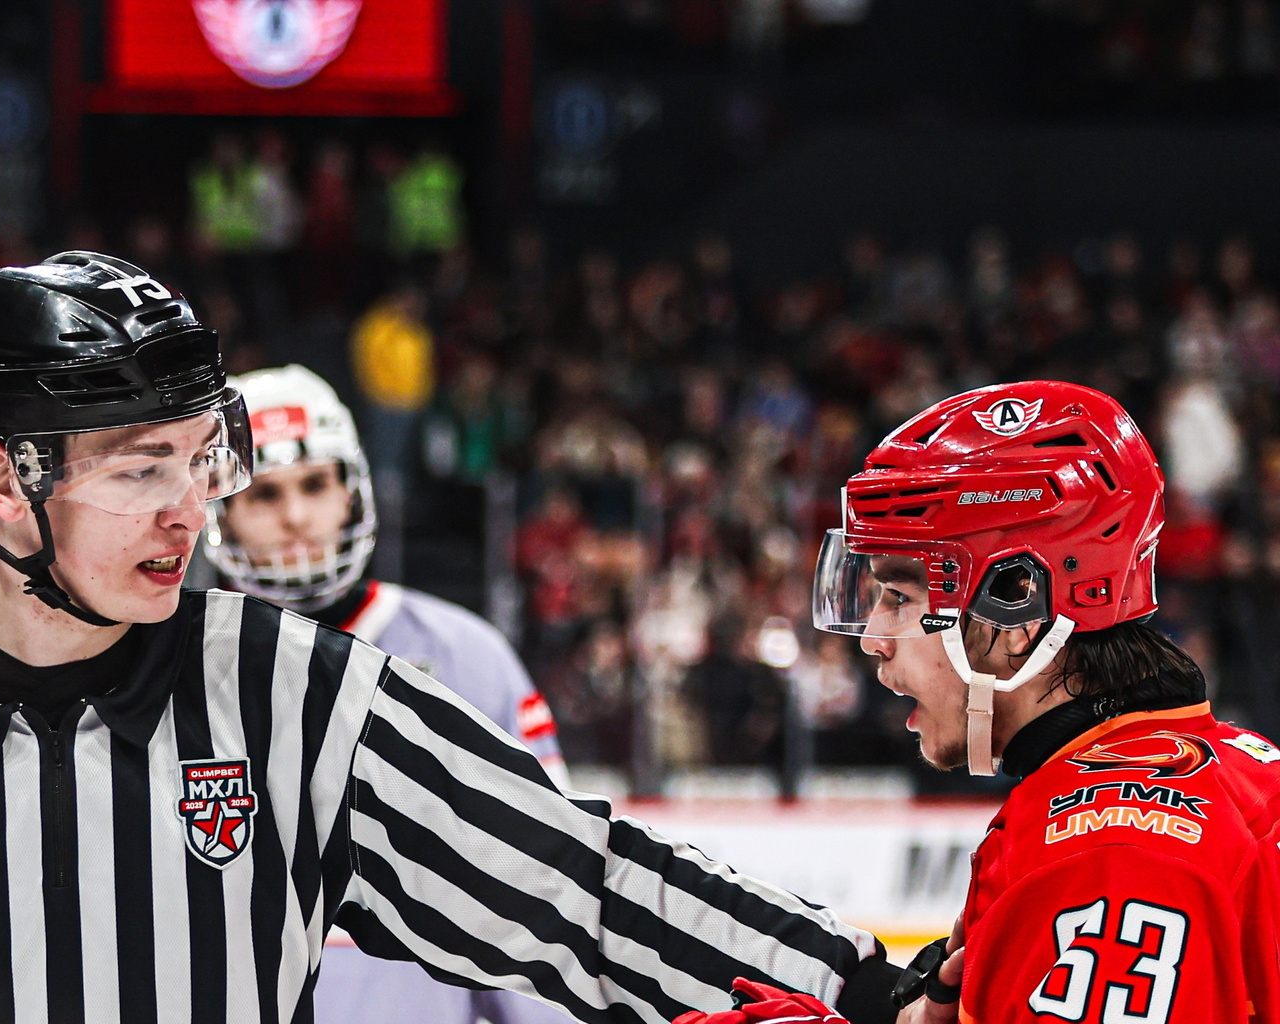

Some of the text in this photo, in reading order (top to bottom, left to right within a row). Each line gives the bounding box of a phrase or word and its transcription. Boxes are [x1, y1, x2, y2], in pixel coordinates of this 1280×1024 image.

[922, 618, 954, 627] CCM
[190, 768, 240, 778] OLIMPBET
[188, 778, 244, 800] МХЛ
[185, 798, 249, 809] 2025 2026
[1047, 781, 1213, 820] УГМК
[1045, 807, 1203, 845] UMMC
